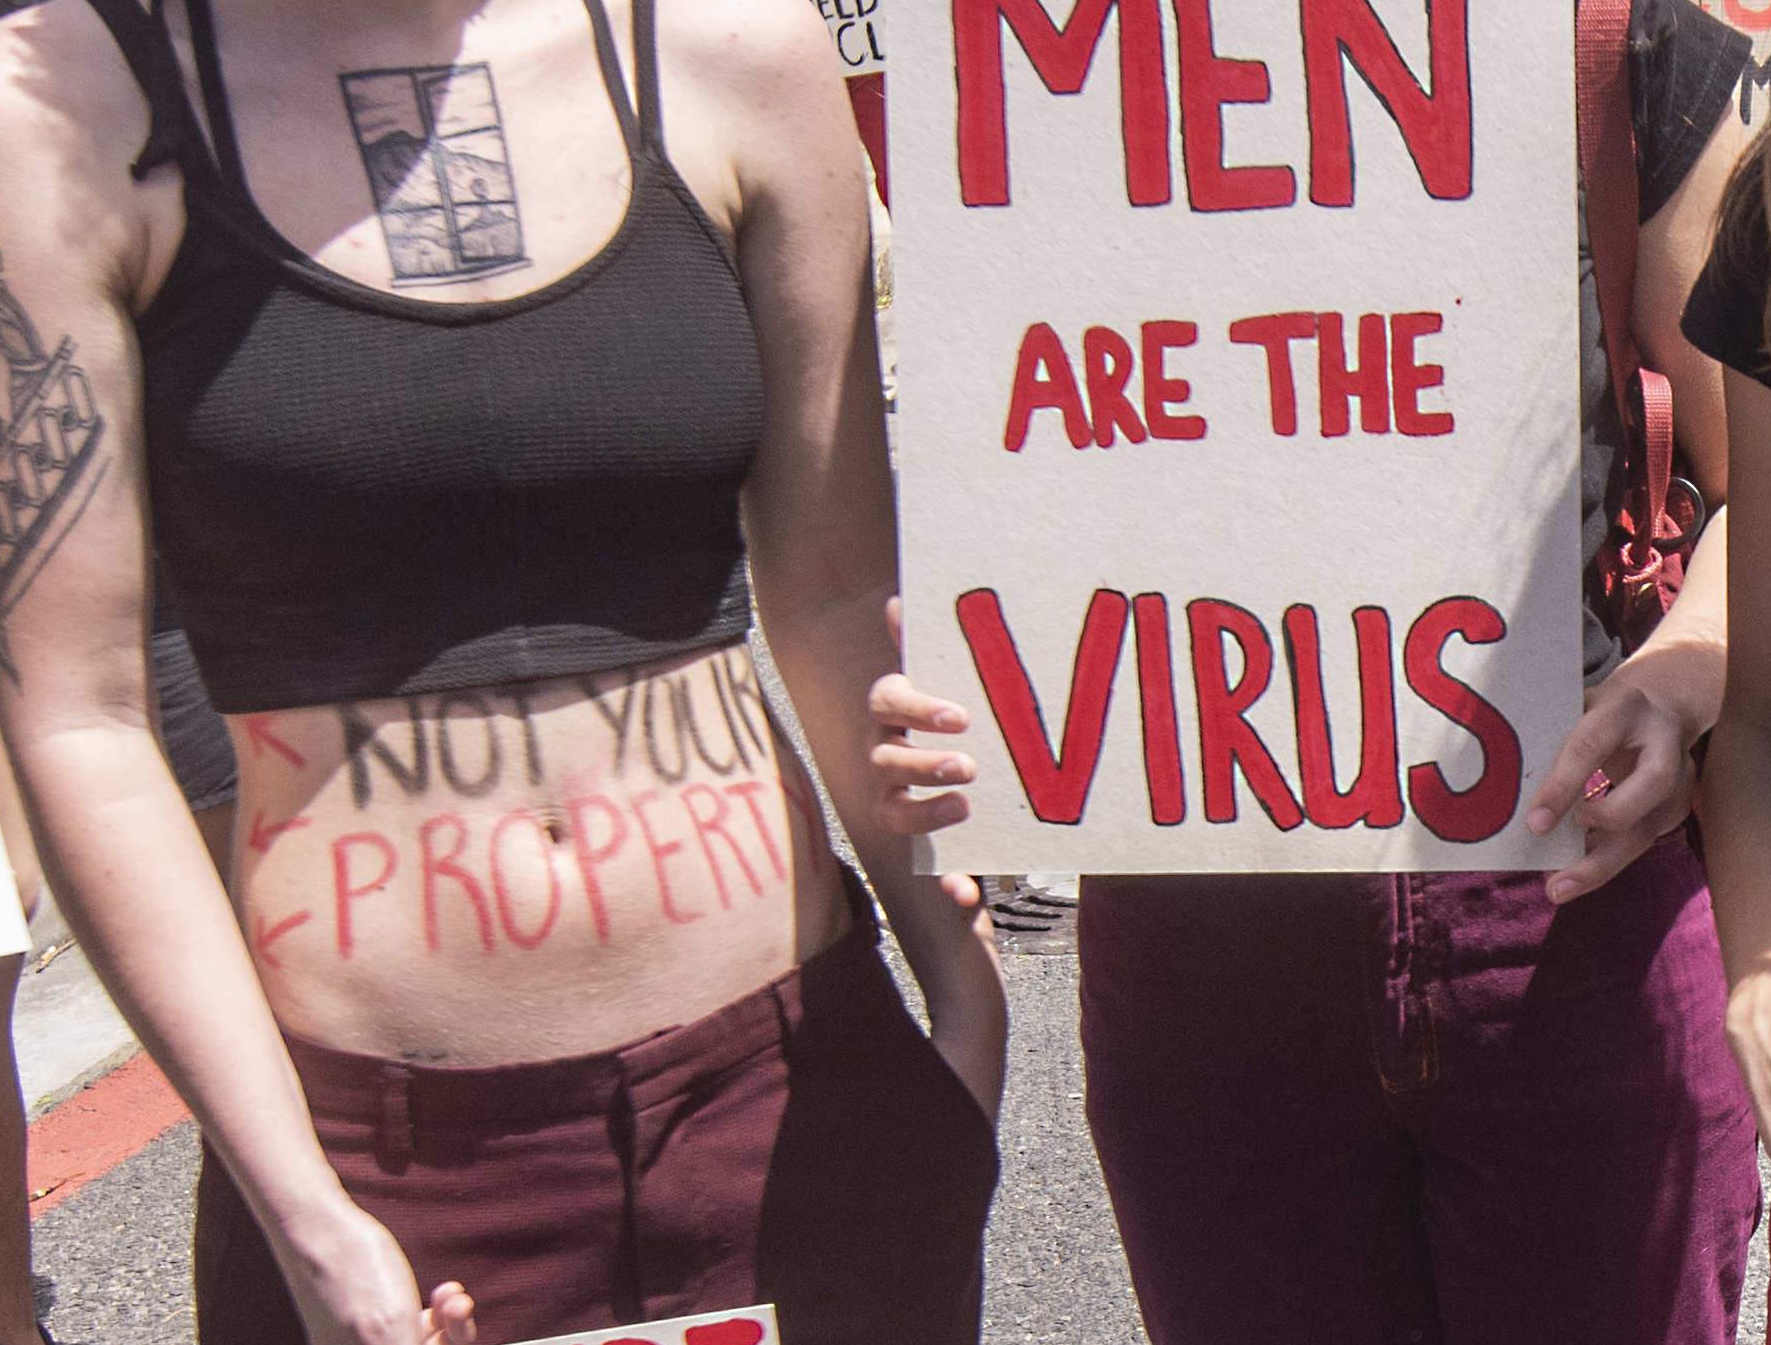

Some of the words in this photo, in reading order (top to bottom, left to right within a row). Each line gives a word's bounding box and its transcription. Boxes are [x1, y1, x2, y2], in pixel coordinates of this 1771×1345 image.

[1004, 318, 1208, 453] ARE
[1228, 310, 1455, 438] THE
[333, 690, 547, 810] NOT
[581, 648, 769, 786] YOUR
[954, 586, 1523, 844] VIRUS
[329, 771, 823, 961] PROPERTY
